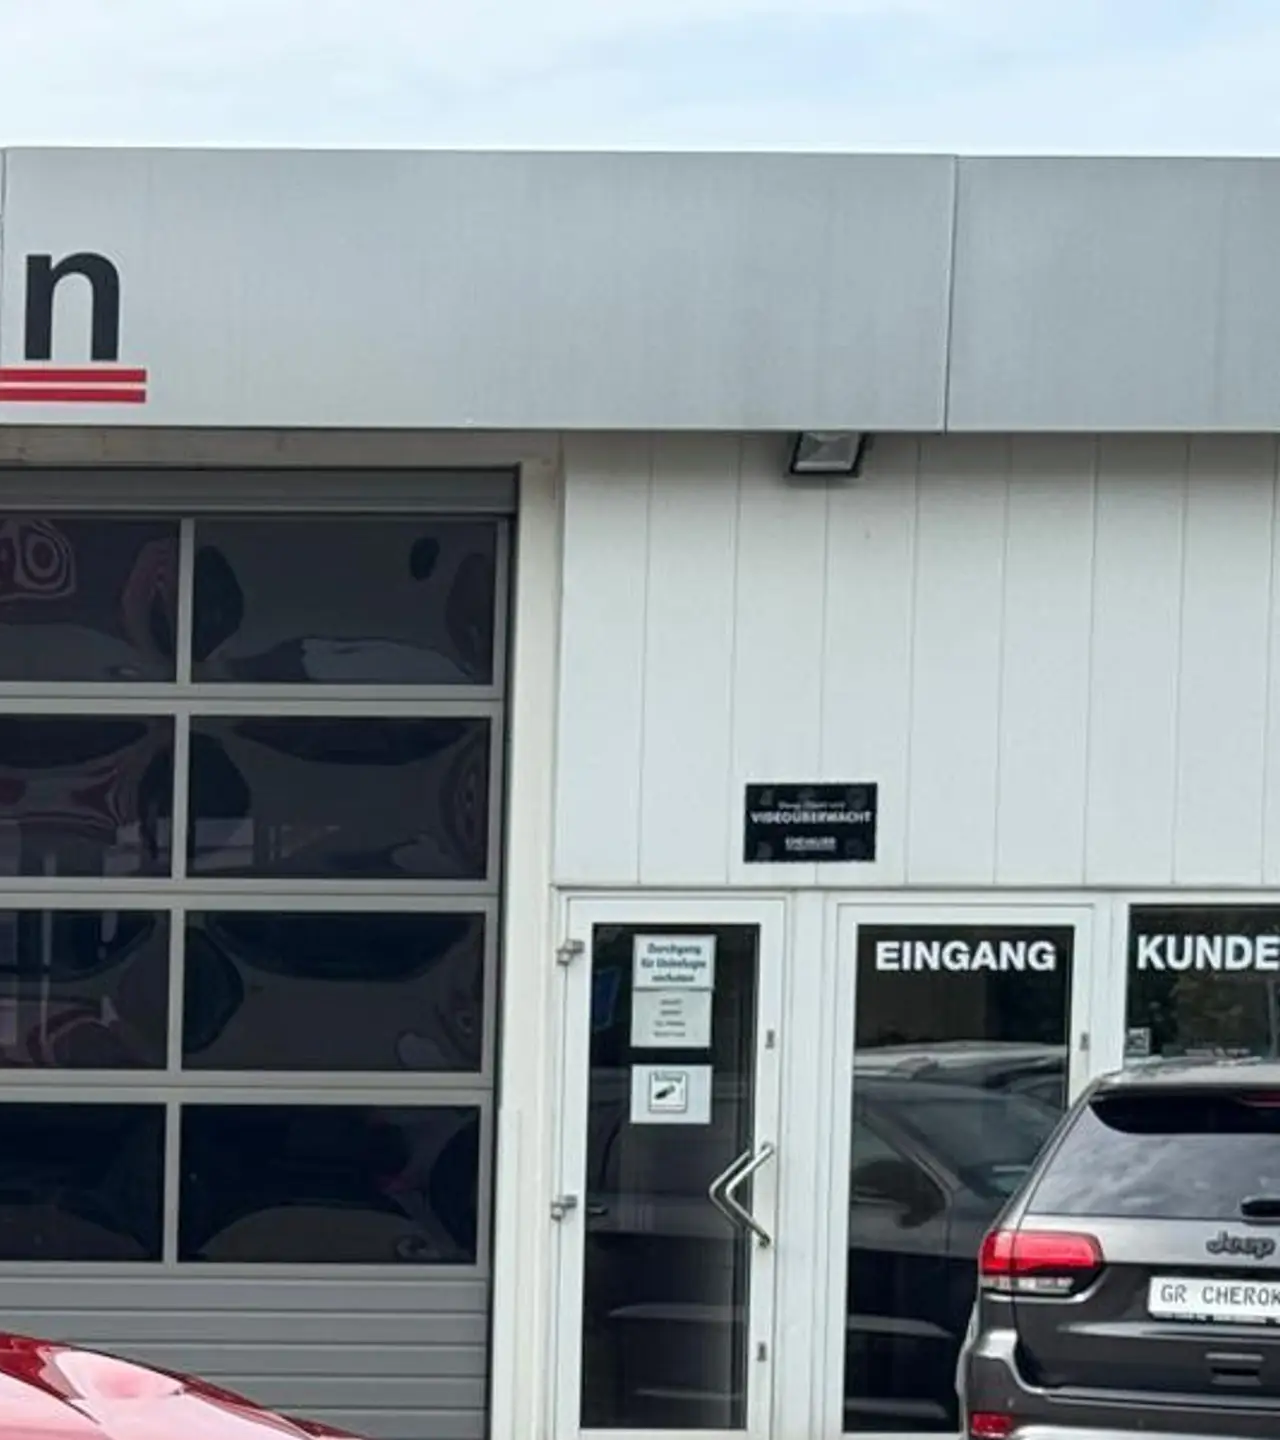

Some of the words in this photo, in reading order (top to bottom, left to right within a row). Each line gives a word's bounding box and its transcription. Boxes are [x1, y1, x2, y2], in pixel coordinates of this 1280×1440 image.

[876, 940, 1057, 972] EINGANG
[1136, 934, 1280, 971] KUNDE
[1205, 1230, 1276, 1260] Jeep
[1160, 1284, 1187, 1304] GR
